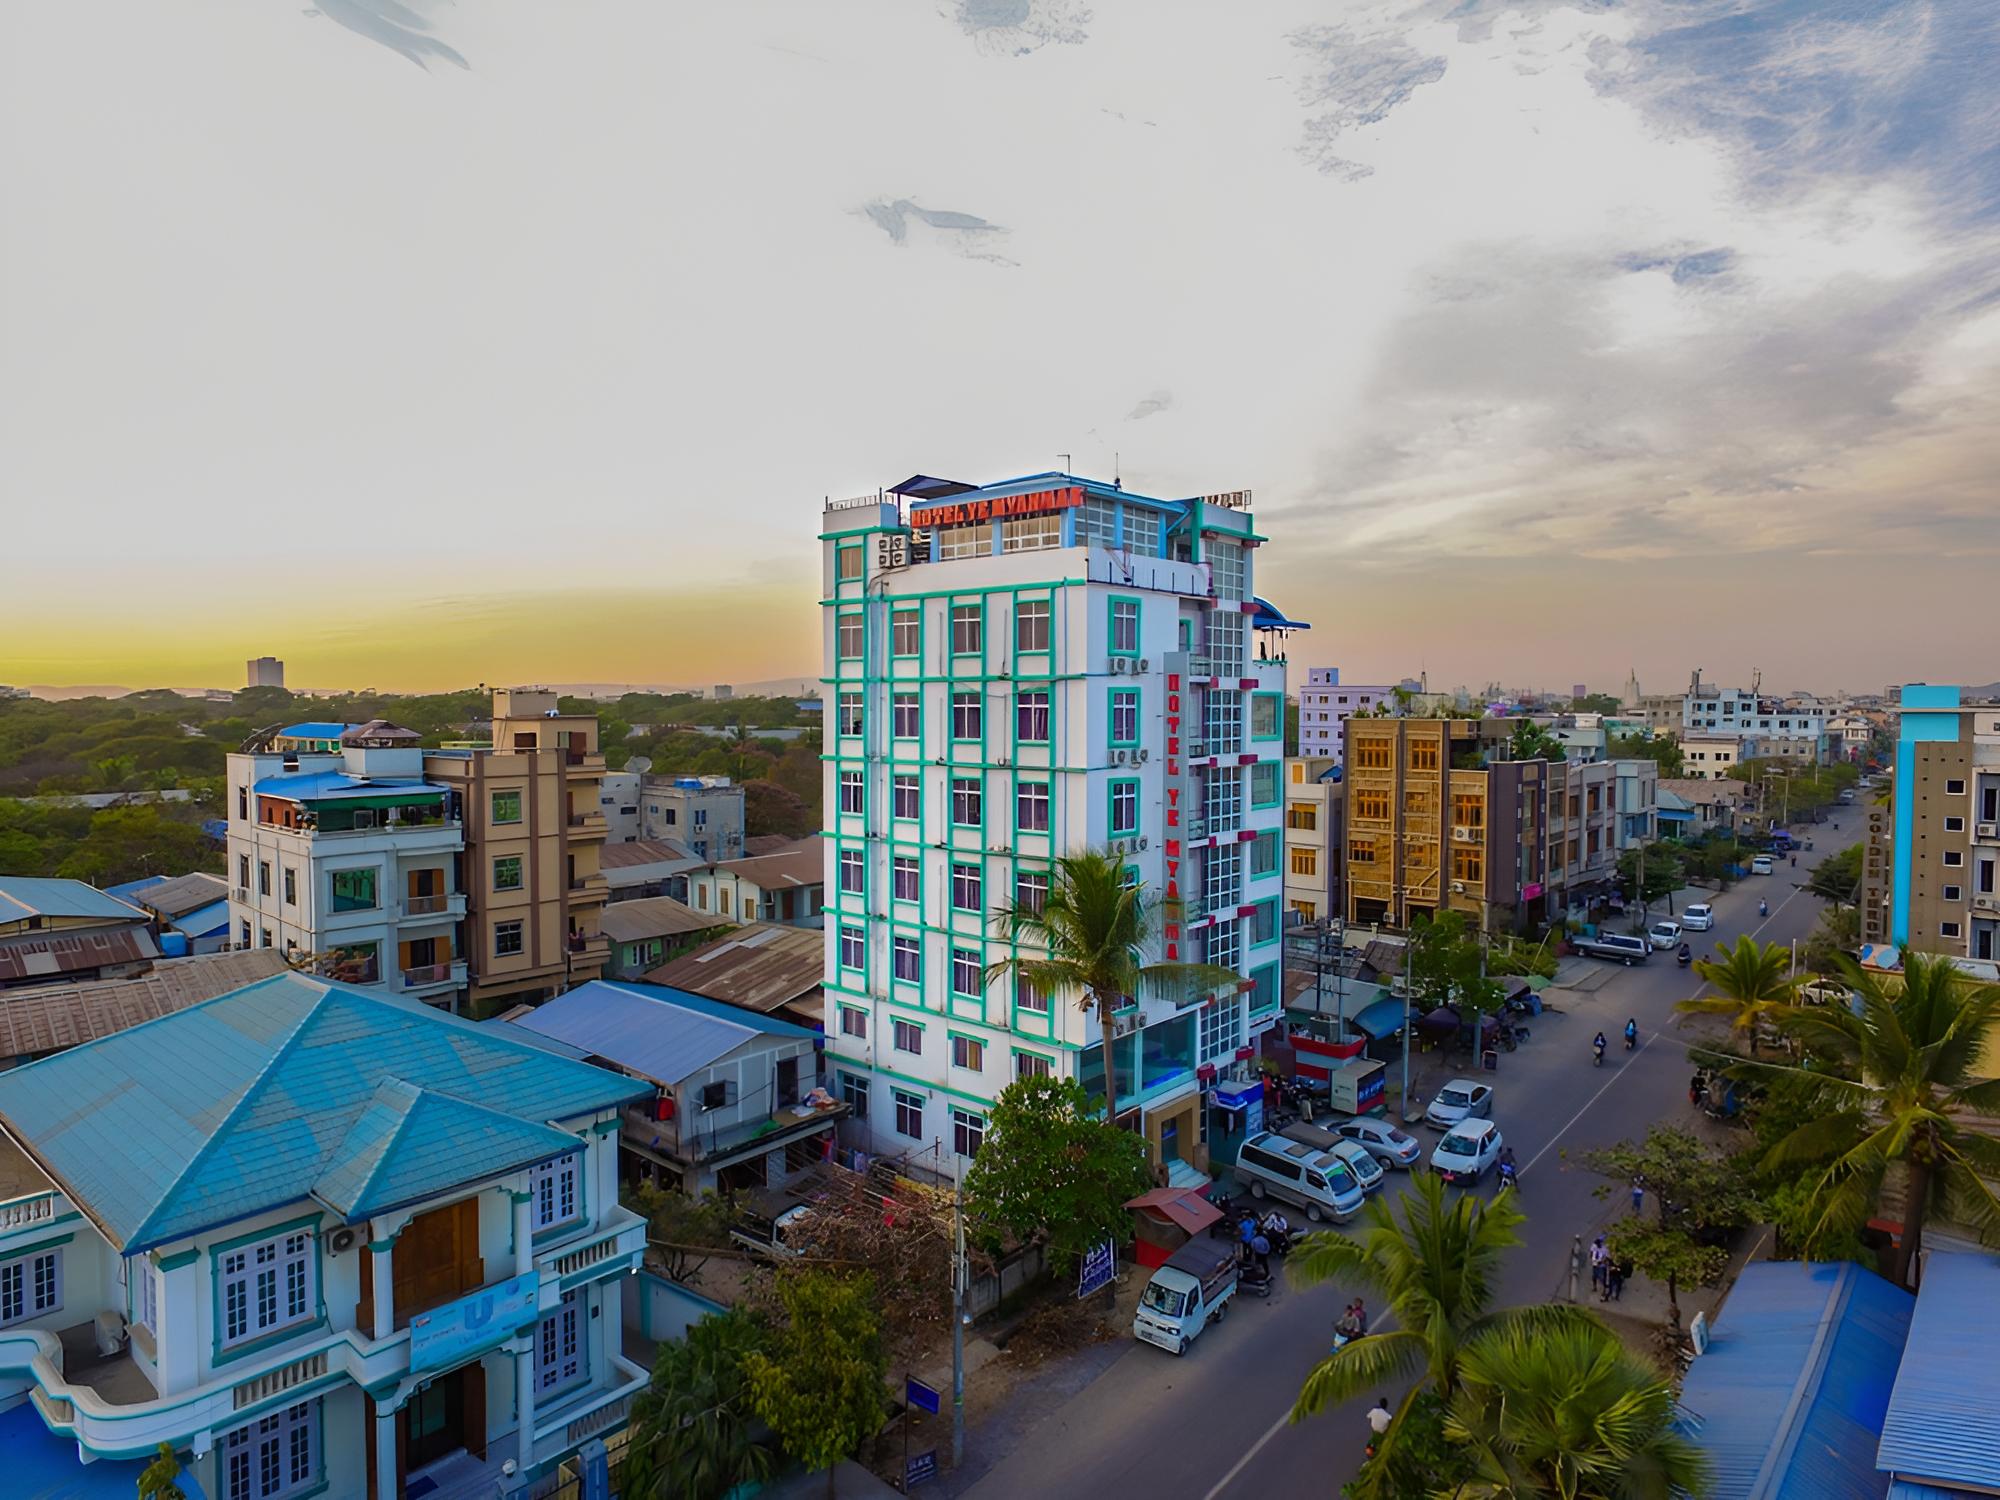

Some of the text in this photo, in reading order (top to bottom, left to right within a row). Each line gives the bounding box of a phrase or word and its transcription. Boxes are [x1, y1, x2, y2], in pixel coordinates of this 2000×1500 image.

[911, 504, 965, 528] HOTEL
[967, 500, 989, 520] YE
[1165, 673, 1180, 961] HOTEL YE MYANMA
